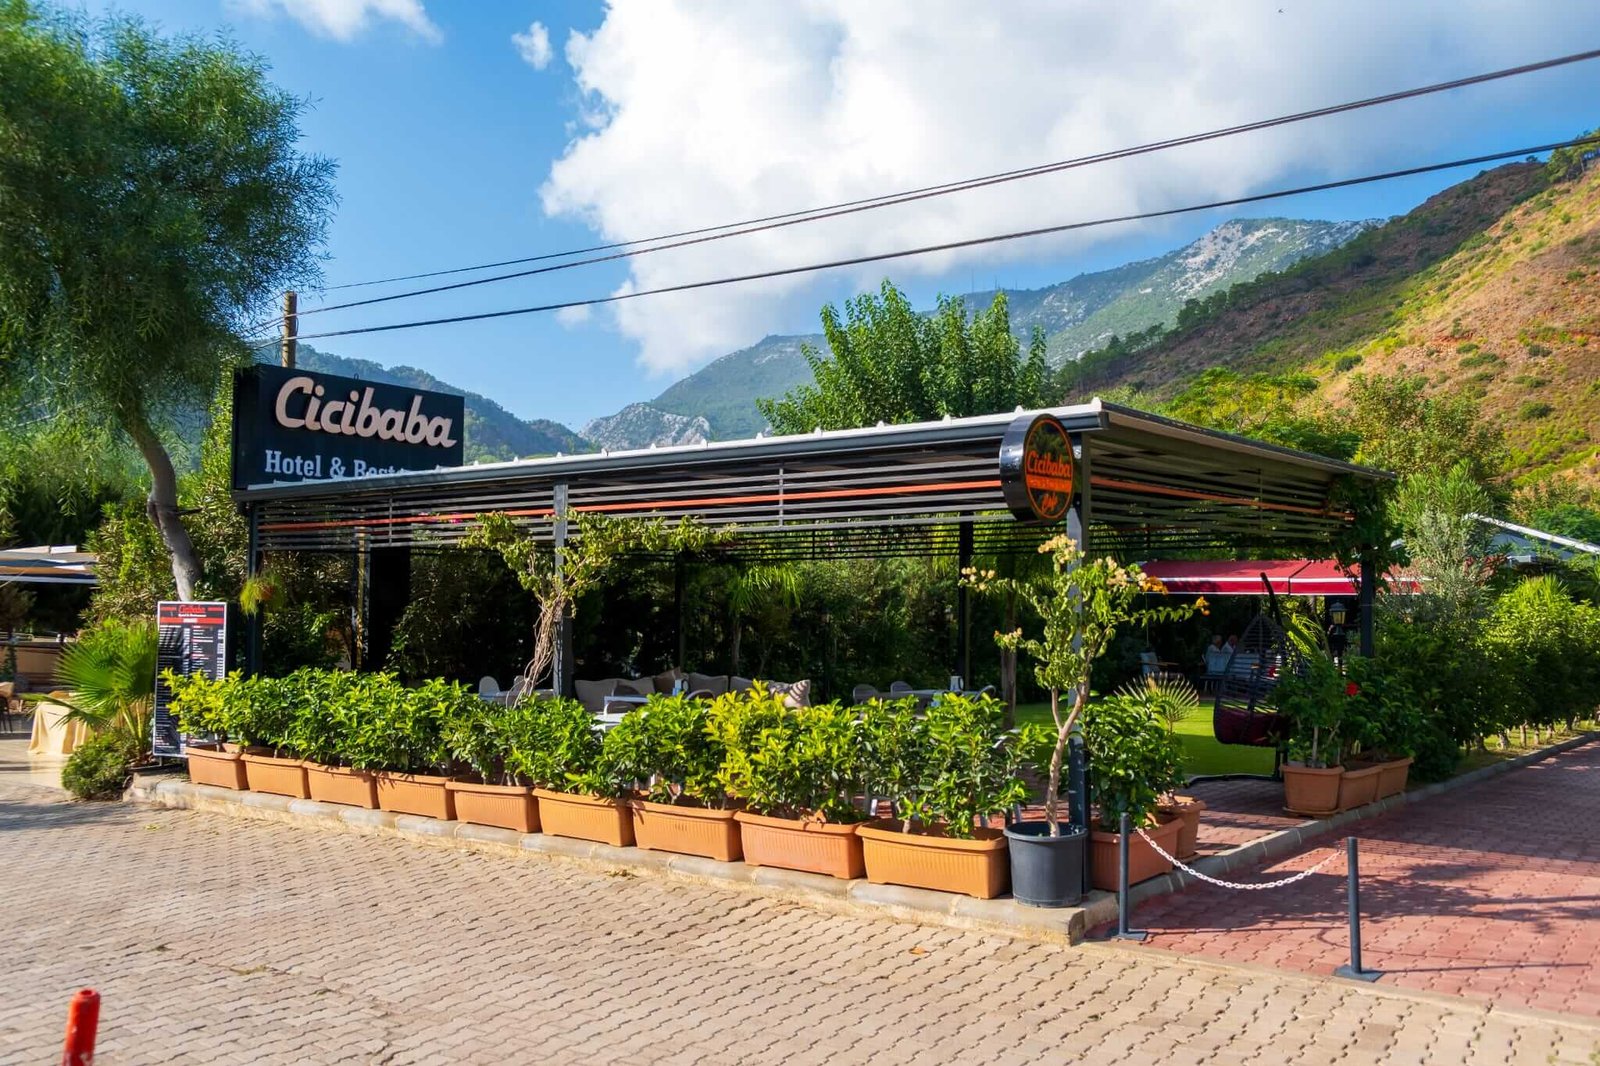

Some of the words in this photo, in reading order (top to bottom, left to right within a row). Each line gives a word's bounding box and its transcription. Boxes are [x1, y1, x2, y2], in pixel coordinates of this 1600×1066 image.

[275, 376, 457, 448] Cicibaba
[265, 450, 322, 477] Hotel
[329, 457, 346, 478] &
